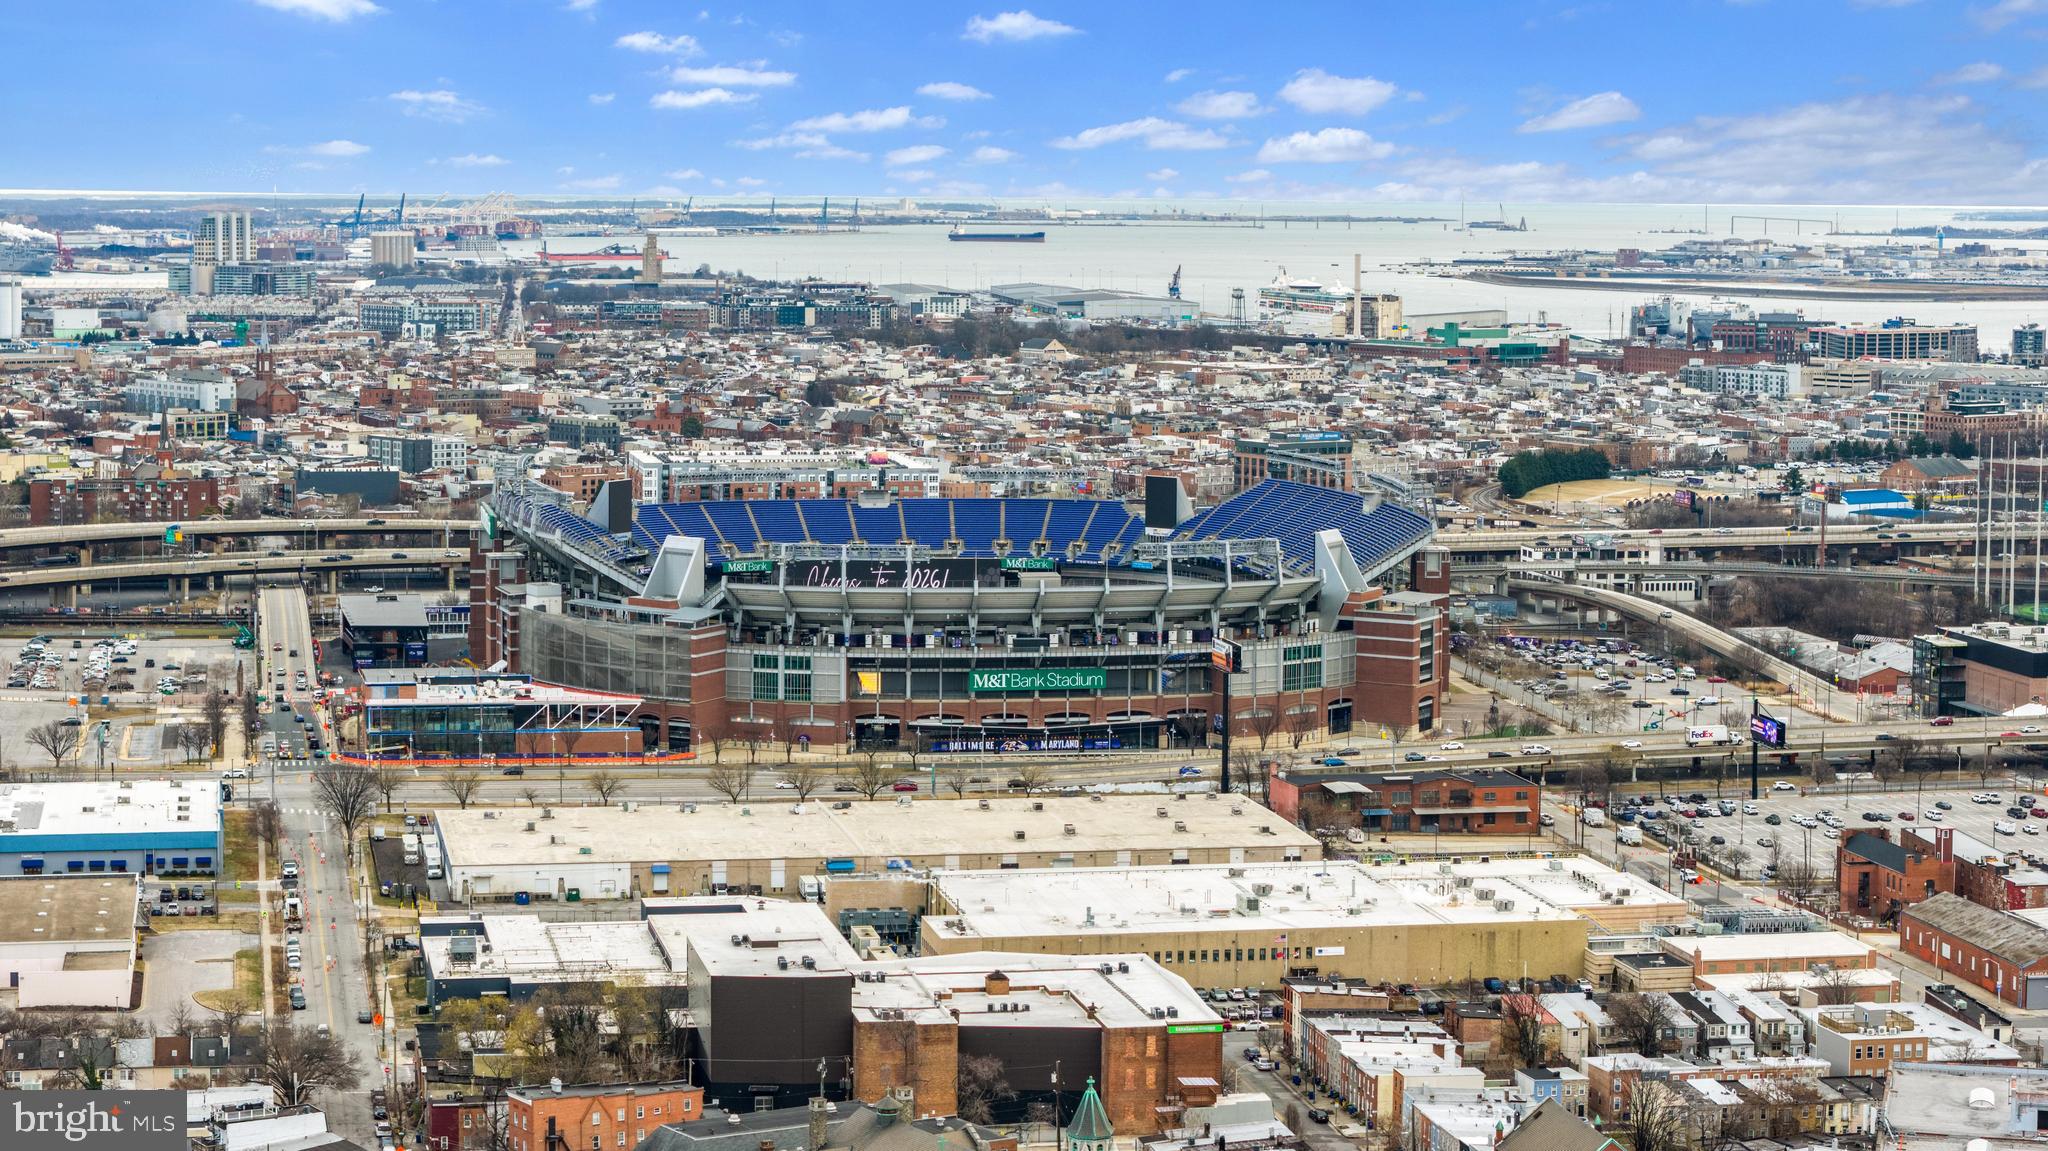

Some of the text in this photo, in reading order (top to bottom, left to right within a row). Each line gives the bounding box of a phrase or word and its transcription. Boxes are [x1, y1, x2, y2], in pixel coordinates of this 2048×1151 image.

[727, 562, 768, 572] M&T Bank
[1006, 559, 1049, 569] M&T Bank
[871, 566, 897, 588] to
[973, 672, 1103, 688] M&T Bank Stadium
[1691, 730, 1713, 739] FedEx
